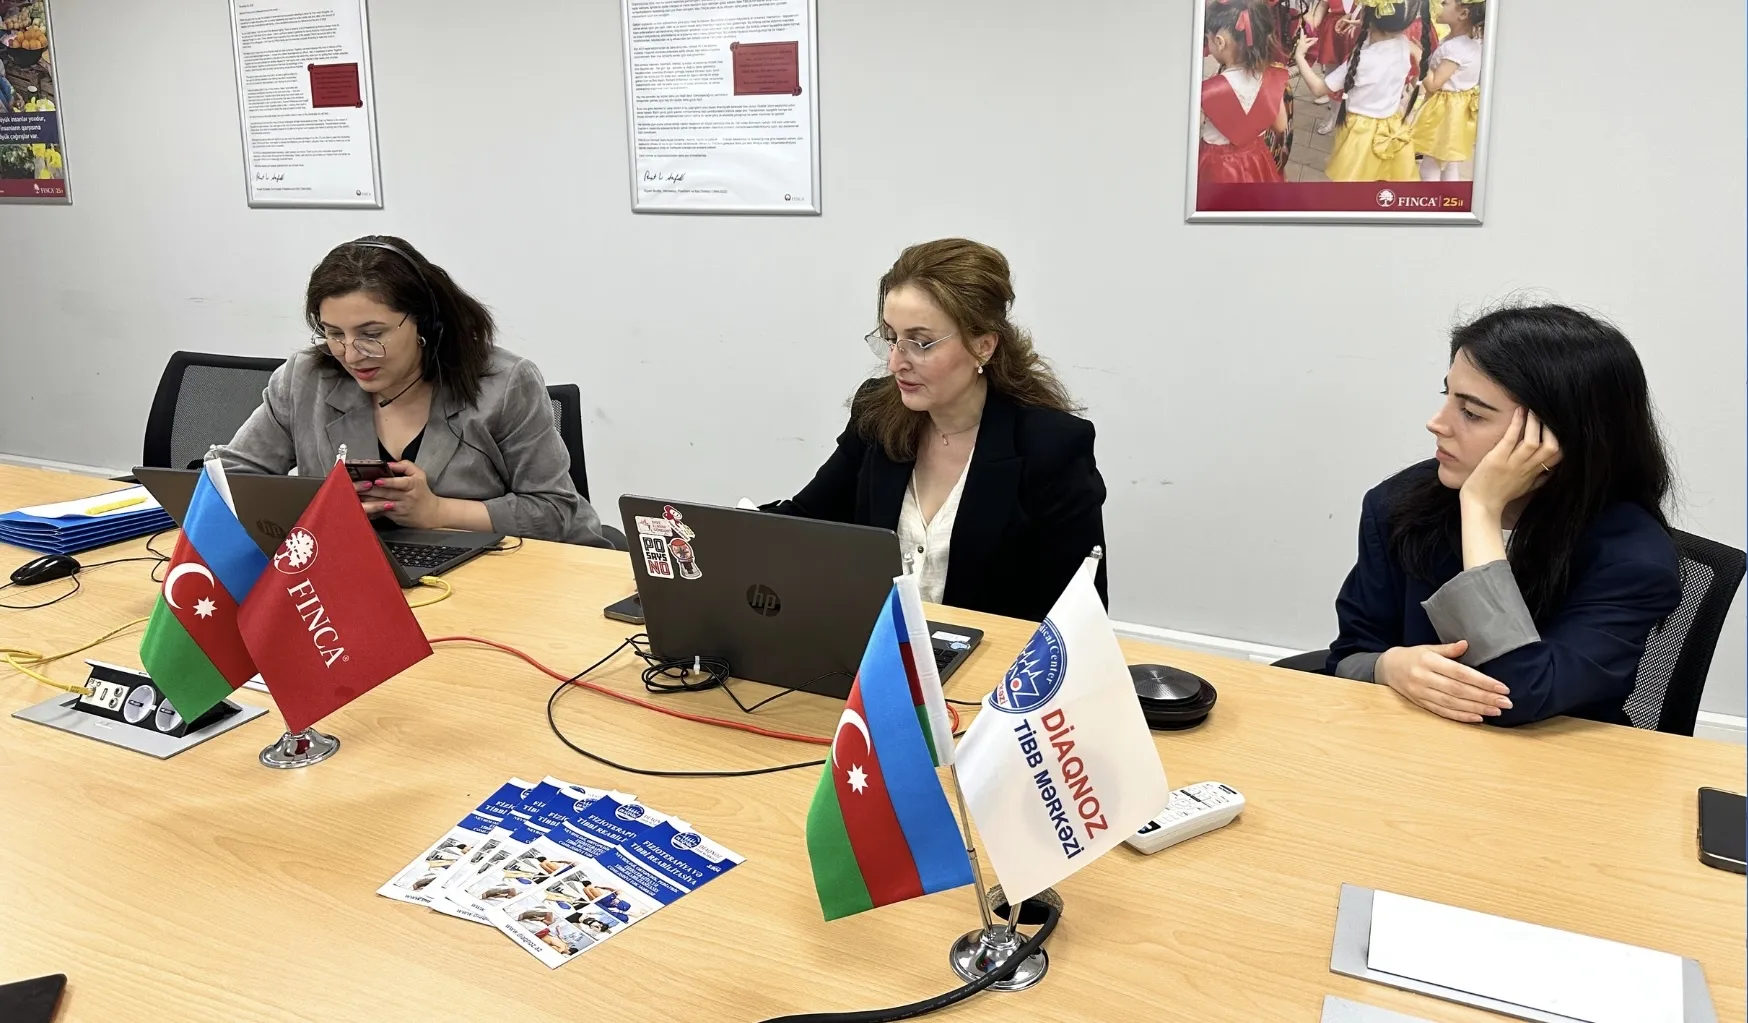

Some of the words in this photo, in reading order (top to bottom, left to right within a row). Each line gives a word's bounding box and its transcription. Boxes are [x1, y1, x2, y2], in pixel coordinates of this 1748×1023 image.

[646, 552, 668, 562] SAYS
[648, 560, 671, 576] NO
[751, 582, 777, 617] hp
[1046, 645, 1060, 685] Center
[1013, 719, 1044, 769] TİBB
[1033, 769, 1085, 860] MƏRKƏZİ
[1041, 708, 1109, 840] DİAQNOZ
[576, 817, 598, 835] TİBBİ
[630, 841, 653, 860] TİBBİ
[648, 855, 697, 886] REABİLİTASİYA
[642, 839, 694, 873] FİZİOTERAPİYA
[691, 867, 703, 878] VƏ
